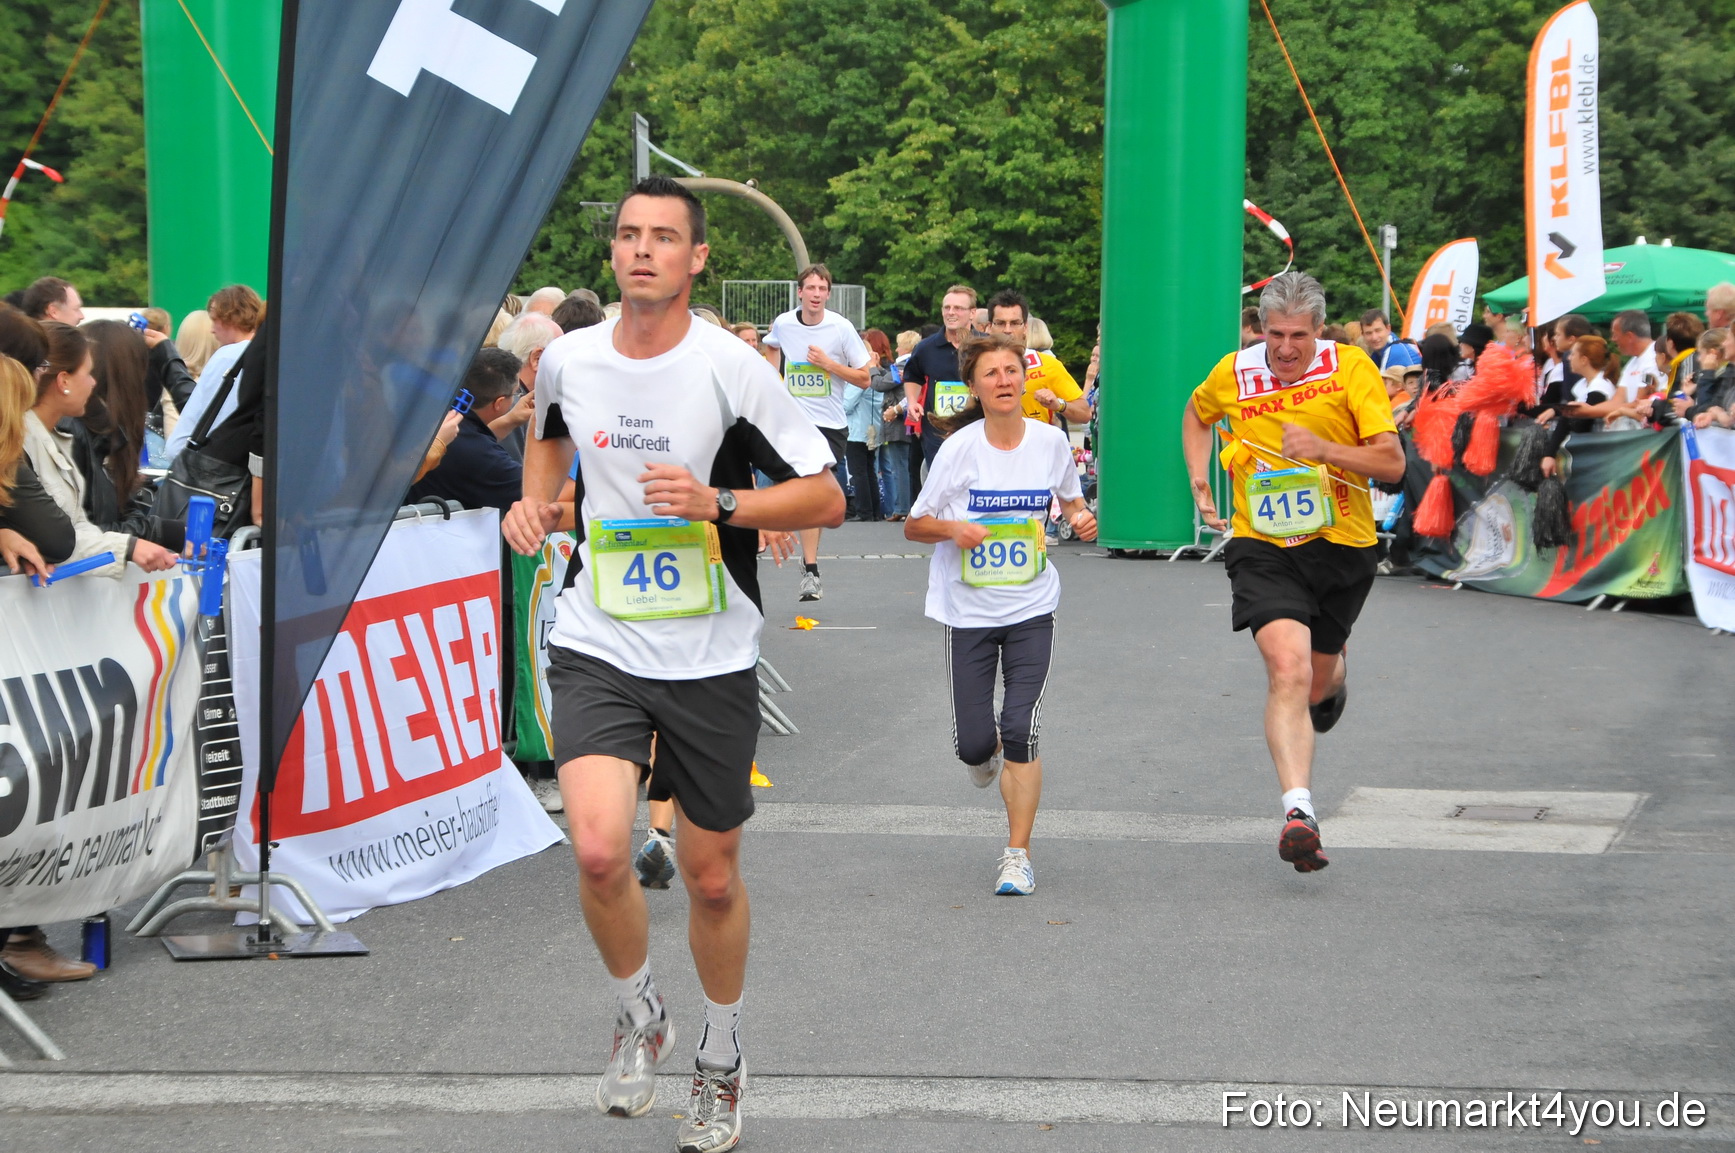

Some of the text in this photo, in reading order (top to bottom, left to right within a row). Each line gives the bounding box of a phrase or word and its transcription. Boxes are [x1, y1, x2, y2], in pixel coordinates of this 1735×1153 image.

[1577, 53, 1596, 175] www.klebl.de
[1424, 269, 1456, 338] BL
[1455, 285, 1474, 335] ebl.de
[788, 374, 824, 387] 1035
[937, 395, 968, 409] 112
[1240, 379, 1345, 421] MAX BÖGL
[617, 415, 654, 429] Team
[610, 433, 671, 453] UniCredit
[975, 495, 1049, 507] STAEDTLER
[1257, 489, 1315, 521] 415
[1273, 520, 1293, 528] Anton
[970, 540, 1028, 569] 896
[622, 551, 681, 593] 46
[974, 569, 1004, 577] Gabriele
[626, 594, 657, 605] Liebel
[205, 748, 231, 763] eizeit
[328, 781, 501, 883] www.meier-baustoffe
